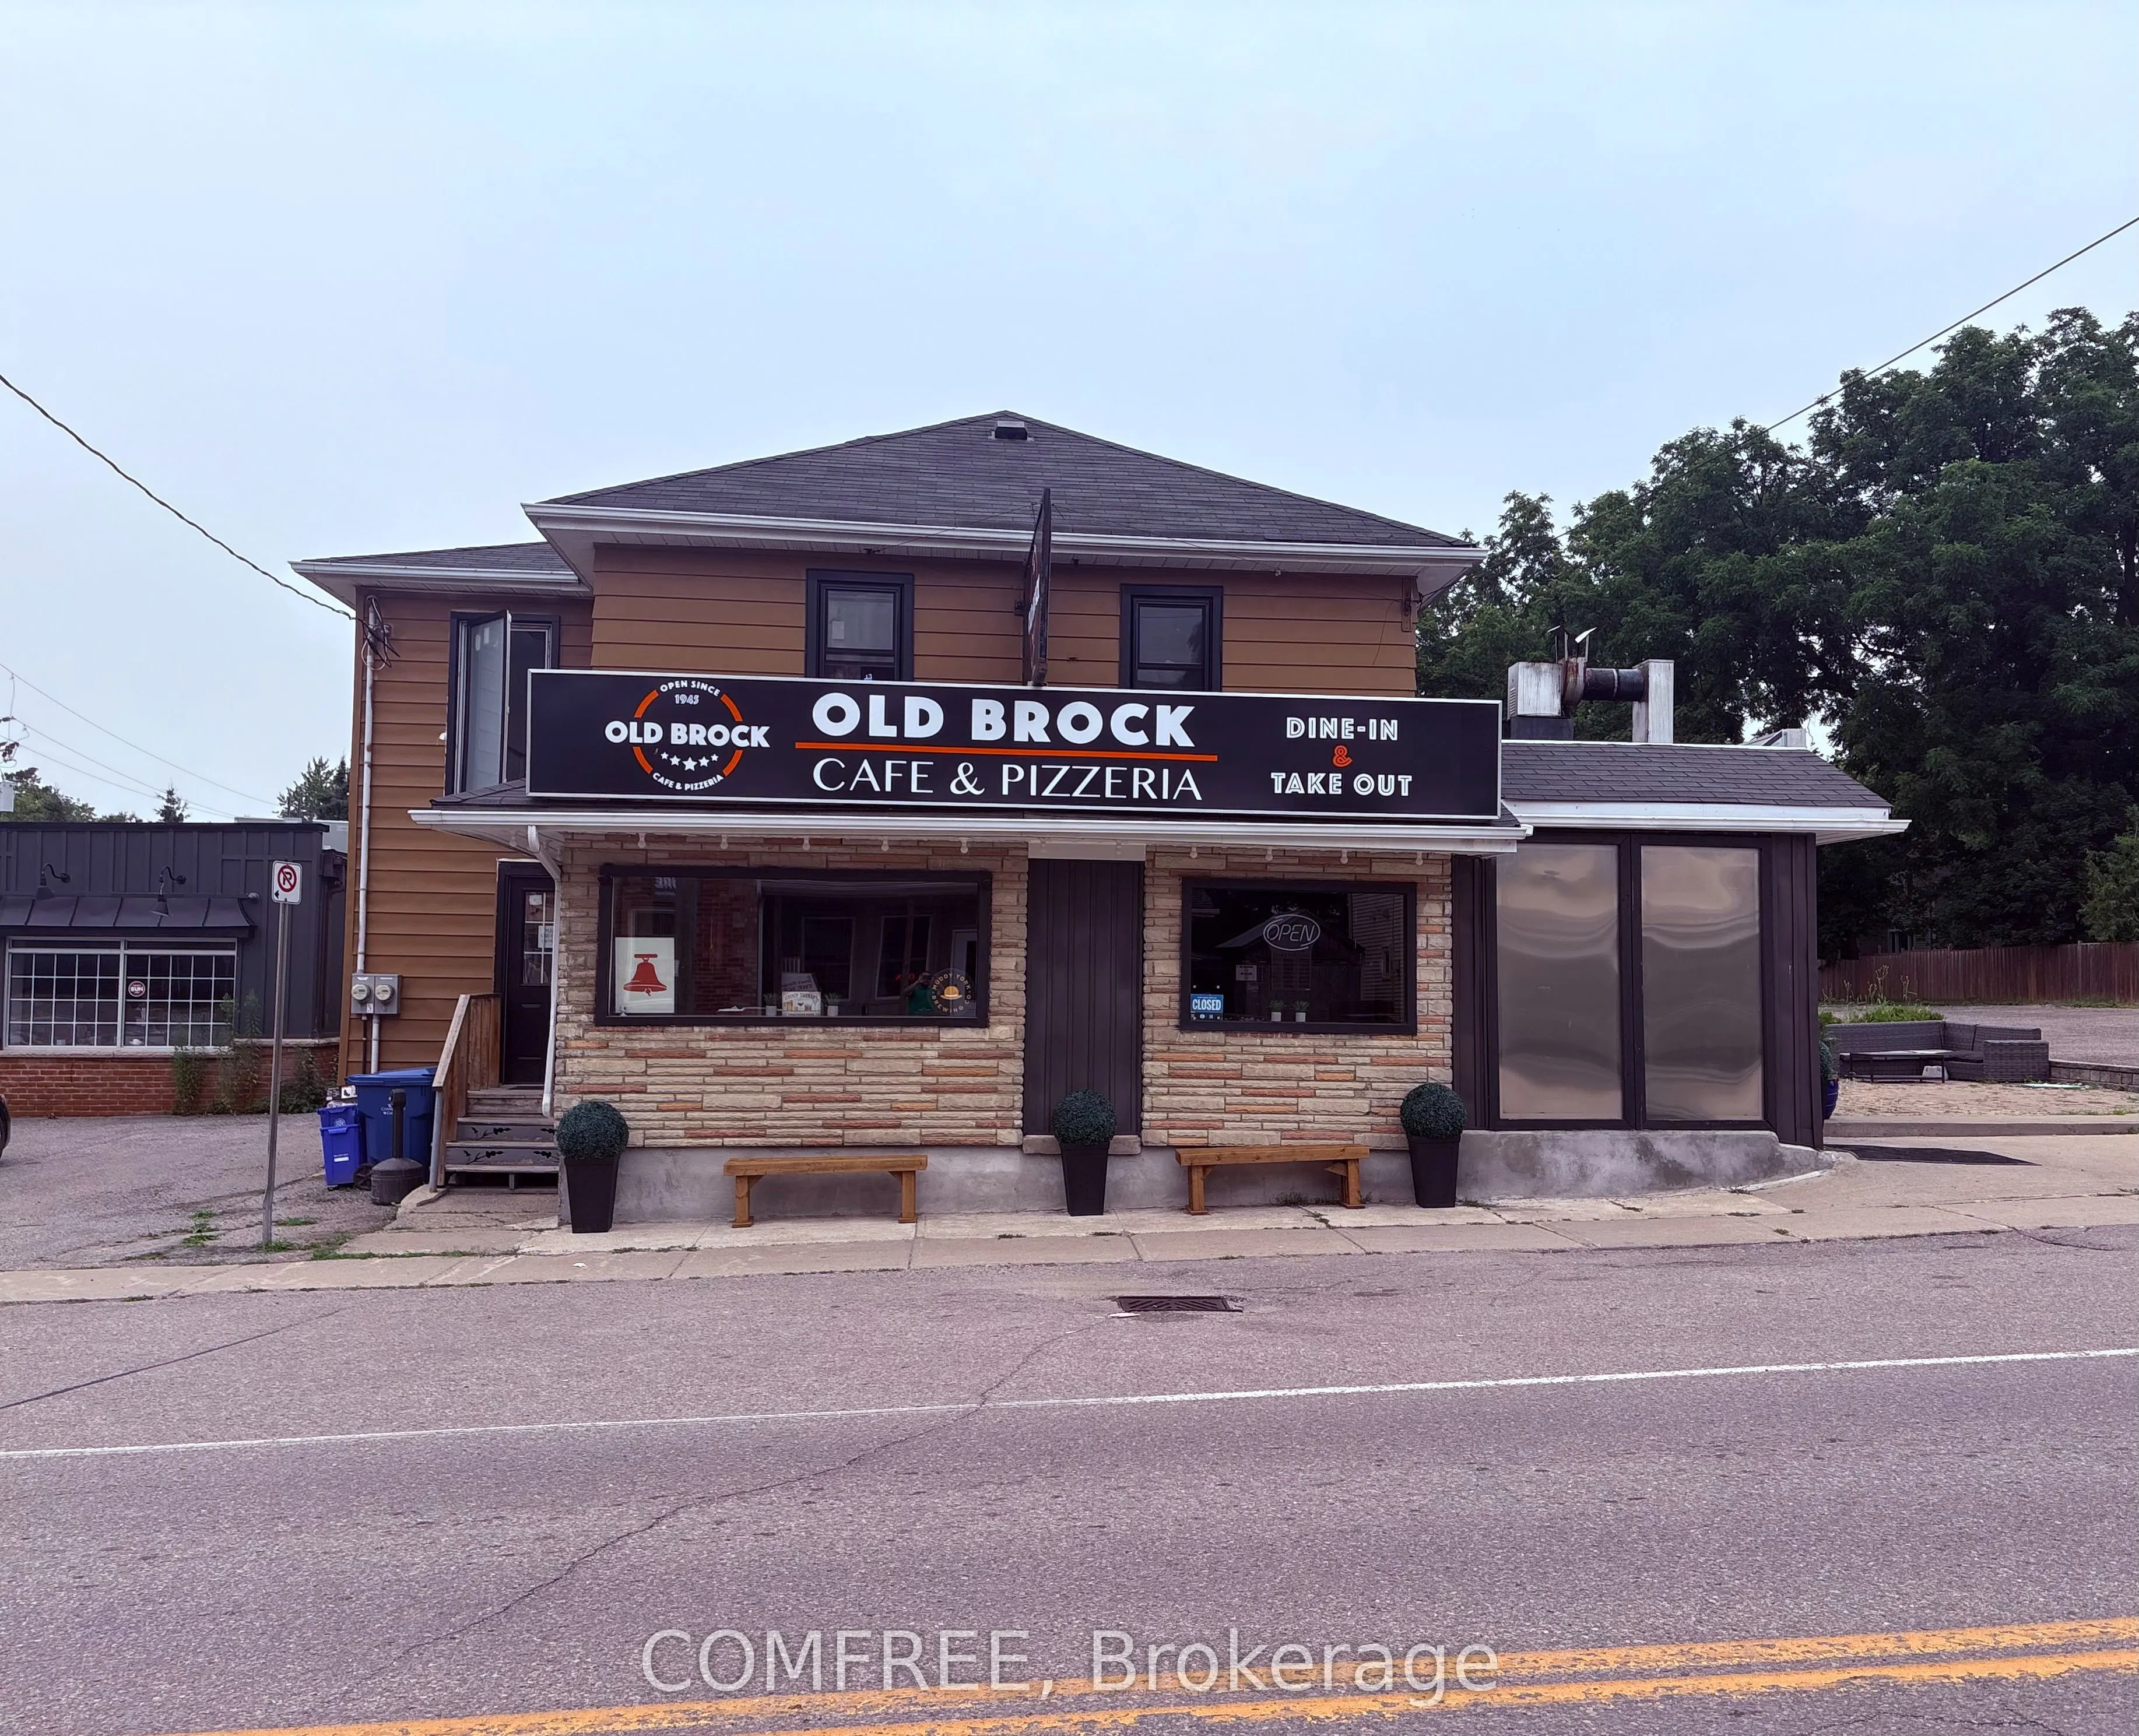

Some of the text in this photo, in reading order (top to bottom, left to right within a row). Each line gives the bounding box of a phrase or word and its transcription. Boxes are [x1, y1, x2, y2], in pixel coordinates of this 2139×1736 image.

[660, 680, 721, 697] OPEN SINCE
[675, 694, 700, 705] 1945
[813, 692, 1195, 747] OLD BROCK
[1286, 716, 1398, 741] DINE-IN
[605, 721, 771, 748] OLD BROCK
[1332, 746, 1352, 768] &
[652, 772, 723, 791] CAFE & PIZZERIA
[813, 758, 1203, 800] CAFE & PIZZERIA
[1270, 772, 1413, 796] TAKE OUT
[1266, 923, 1315, 942] OPEN
[932, 973, 971, 990] MUDDY YORK
[932, 995, 964, 1013] BREWING
[1192, 999, 1221, 1011] CLOSED
